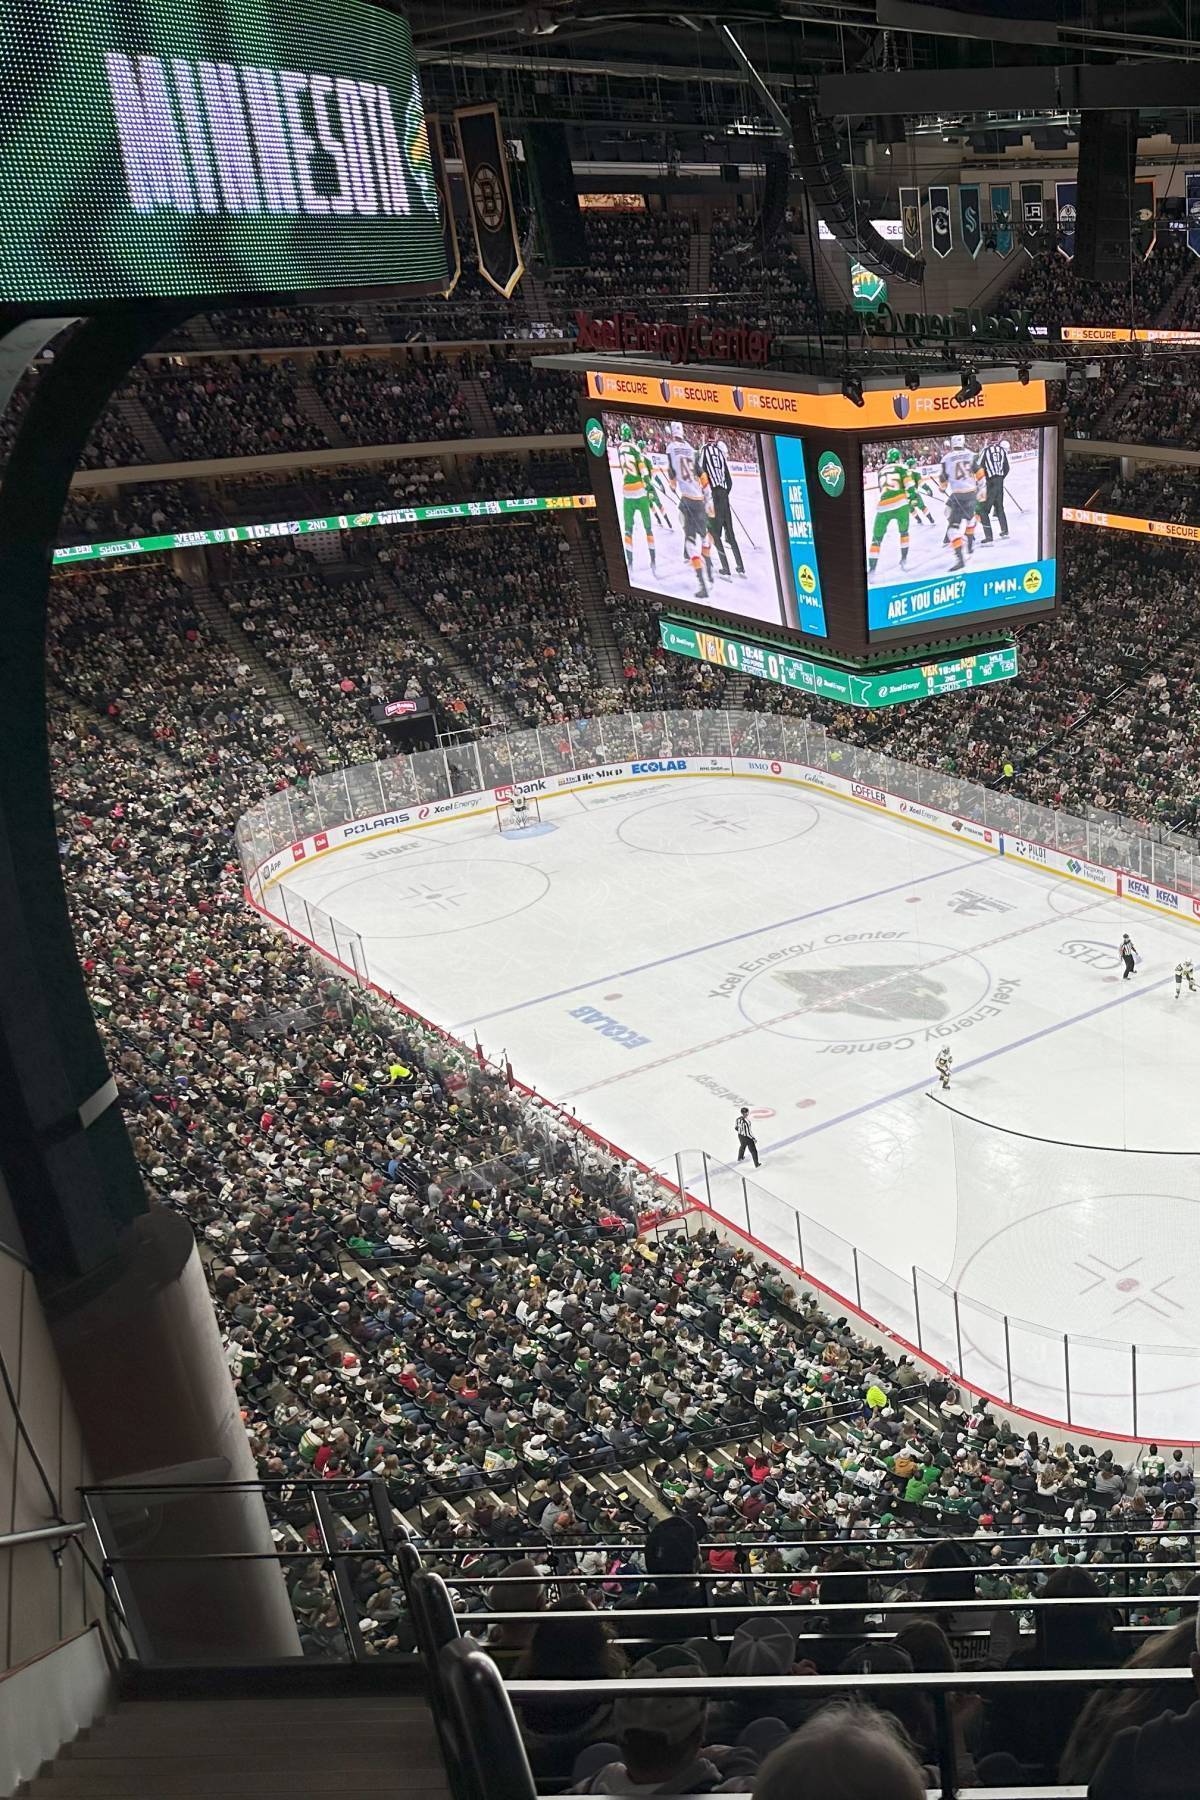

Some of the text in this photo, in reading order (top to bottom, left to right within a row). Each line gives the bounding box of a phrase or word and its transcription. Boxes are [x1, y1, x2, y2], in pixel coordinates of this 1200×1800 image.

[105, 52, 411, 216] MINNESOTA
[575, 310, 775, 365] Xcel Energy Center
[747, 394, 798, 413] FRSECURE
[915, 394, 985, 412] FRSECURE
[788, 486, 803, 503] ARE
[378, 511, 418, 525] WILD
[790, 503, 805, 521] YOU
[1075, 509, 1091, 523] ON
[1093, 512, 1108, 525] ICE
[307, 521, 328, 530] 2ND
[788, 522, 813, 539] GAME?
[1155, 522, 1199, 538] FRSECURE
[888, 580, 966, 620] ARE YOU GAME?
[727, 644, 738, 667] 0
[768, 655, 778, 679] 0
[966, 668, 973, 680] 0
[927, 677, 934, 688] 0
[632, 760, 687, 774] ECOLAB
[748, 762, 768, 771] BMO
[851, 783, 886, 803] LOFFLER
[434, 798, 482, 814] Xcel Energy
[909, 807, 921, 816] Xcel
[343, 813, 410, 837] POLARIS
[1028, 844, 1047, 858] PILOT
[707, 926, 911, 1000] Xcel Energy Center
[815, 976, 1023, 1057] Xcel Energy Center
[567, 1004, 653, 1051] ECOLAB
